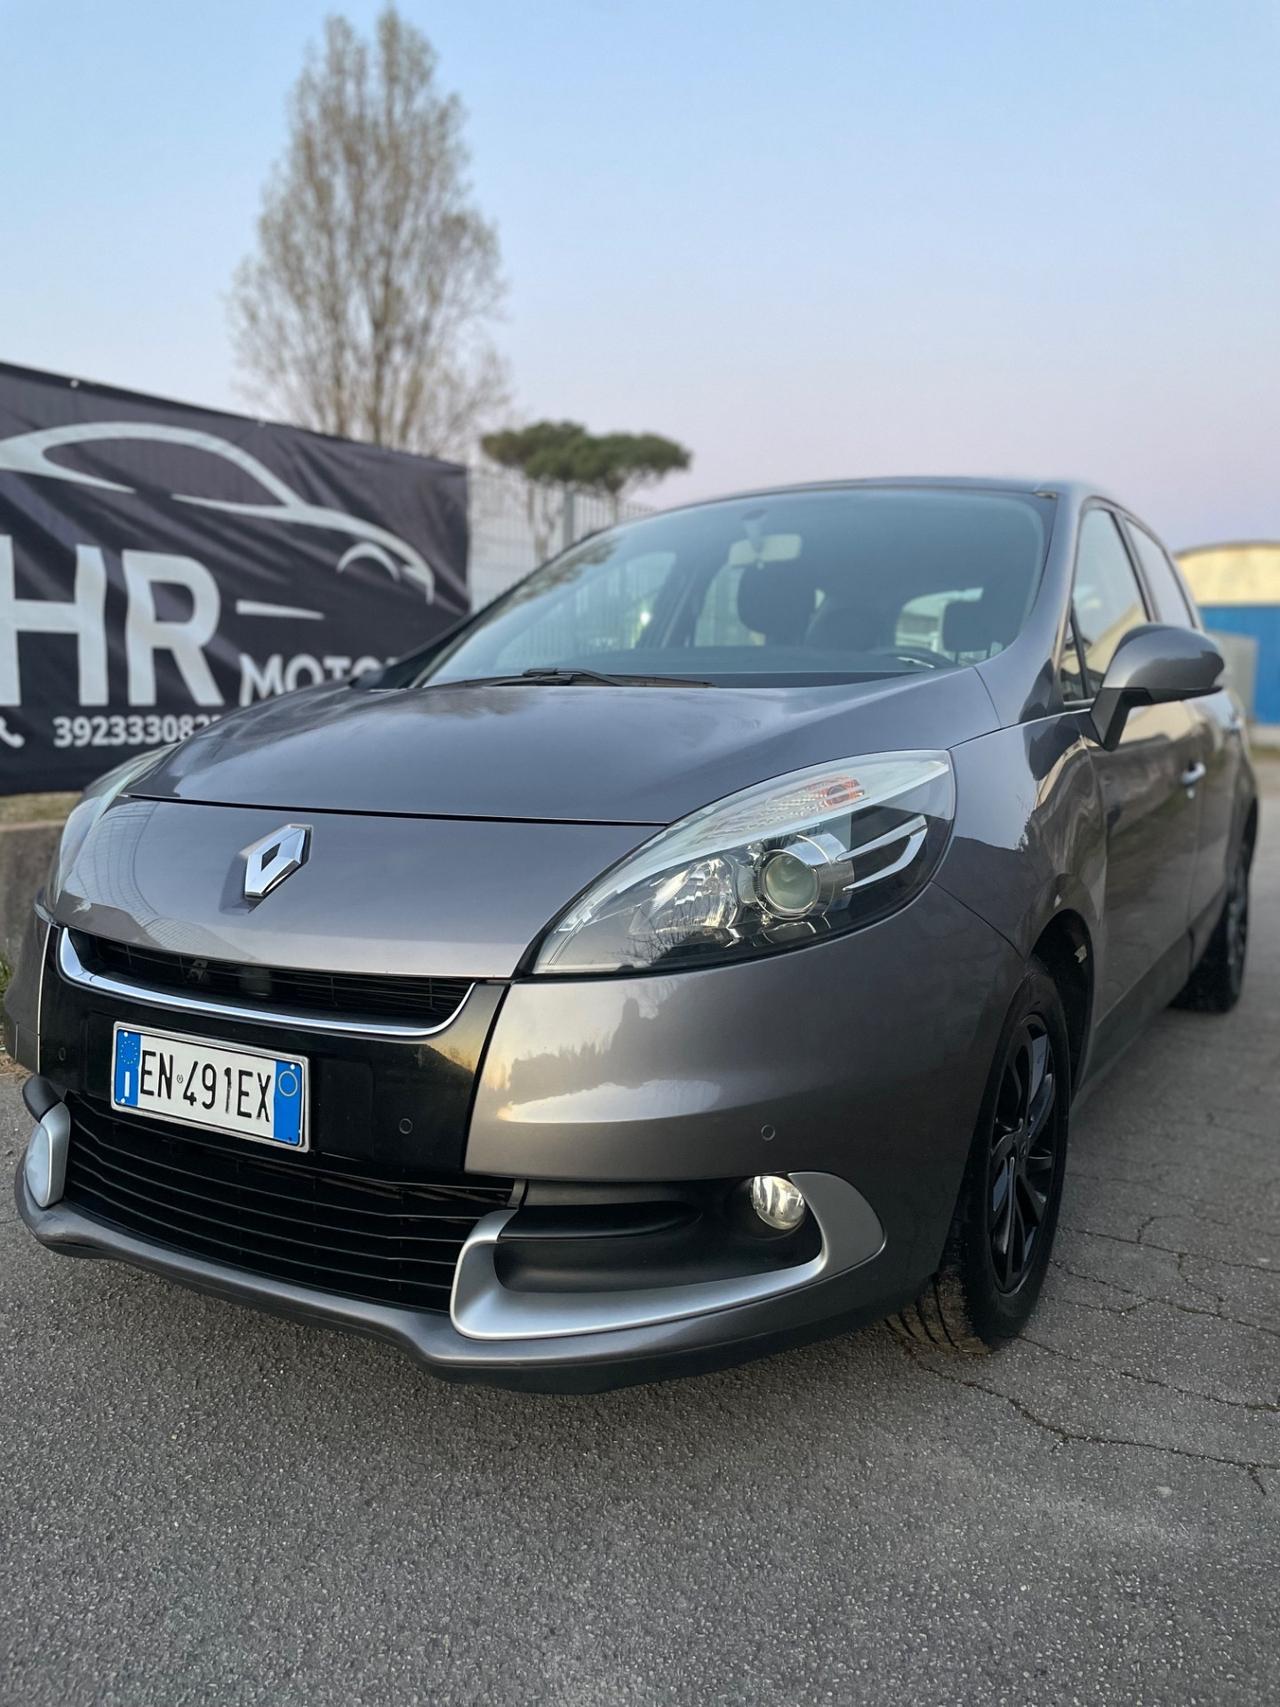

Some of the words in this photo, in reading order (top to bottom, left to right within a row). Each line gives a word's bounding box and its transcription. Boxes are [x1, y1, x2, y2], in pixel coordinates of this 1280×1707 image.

[52, 714, 222, 747] 39233308
[124, 1071, 131, 1098] I
[140, 1050, 174, 1100] EN
[182, 1060, 272, 1122] 491EX
